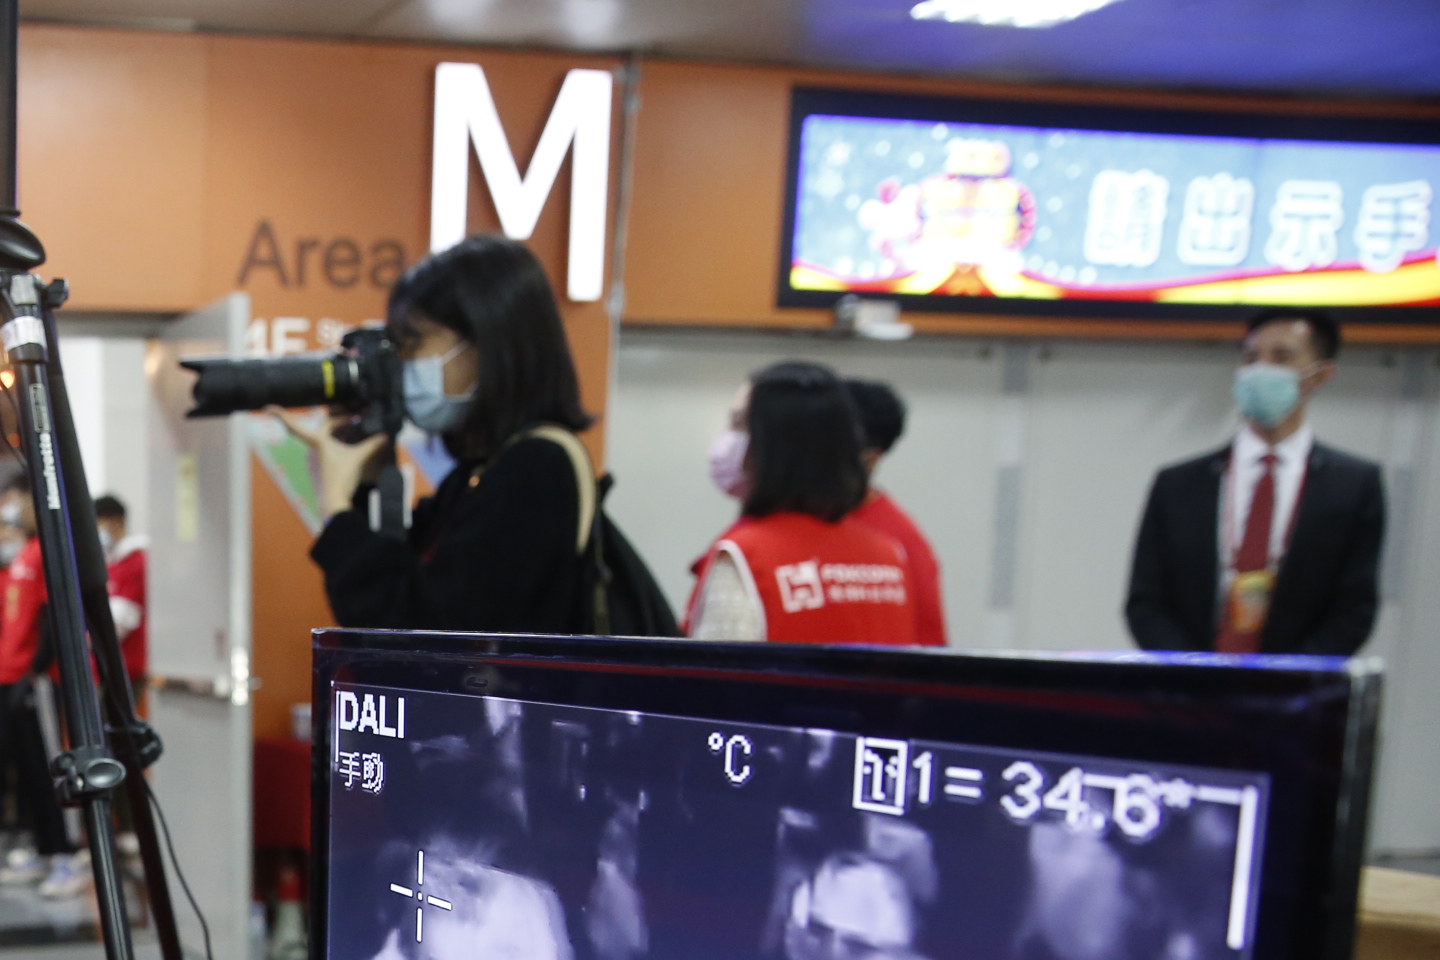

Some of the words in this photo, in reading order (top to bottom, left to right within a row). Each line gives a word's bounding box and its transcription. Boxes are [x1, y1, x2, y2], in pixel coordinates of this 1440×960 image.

[236, 218, 409, 290] Area
[430, 61, 613, 301] M
[339, 690, 405, 739] DALI
[339, 751, 384, 793] 手動
